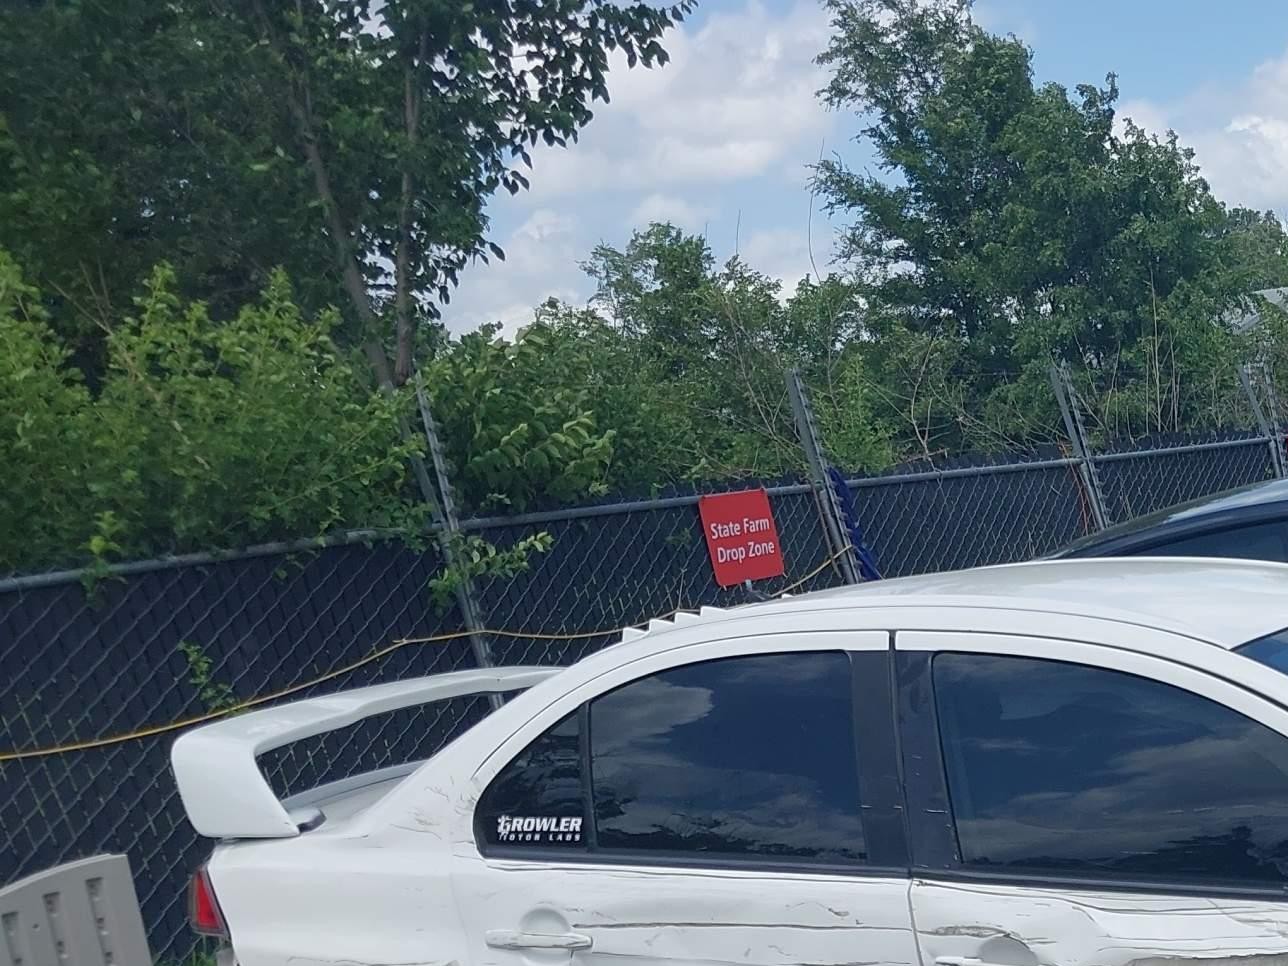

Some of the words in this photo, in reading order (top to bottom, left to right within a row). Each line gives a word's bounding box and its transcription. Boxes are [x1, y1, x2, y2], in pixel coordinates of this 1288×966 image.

[710, 522, 741, 539] State
[743, 517, 770, 534] Farm
[717, 546, 746, 563] Drop
[747, 541, 775, 557] Zone
[497, 815, 583, 833] GROWLER
